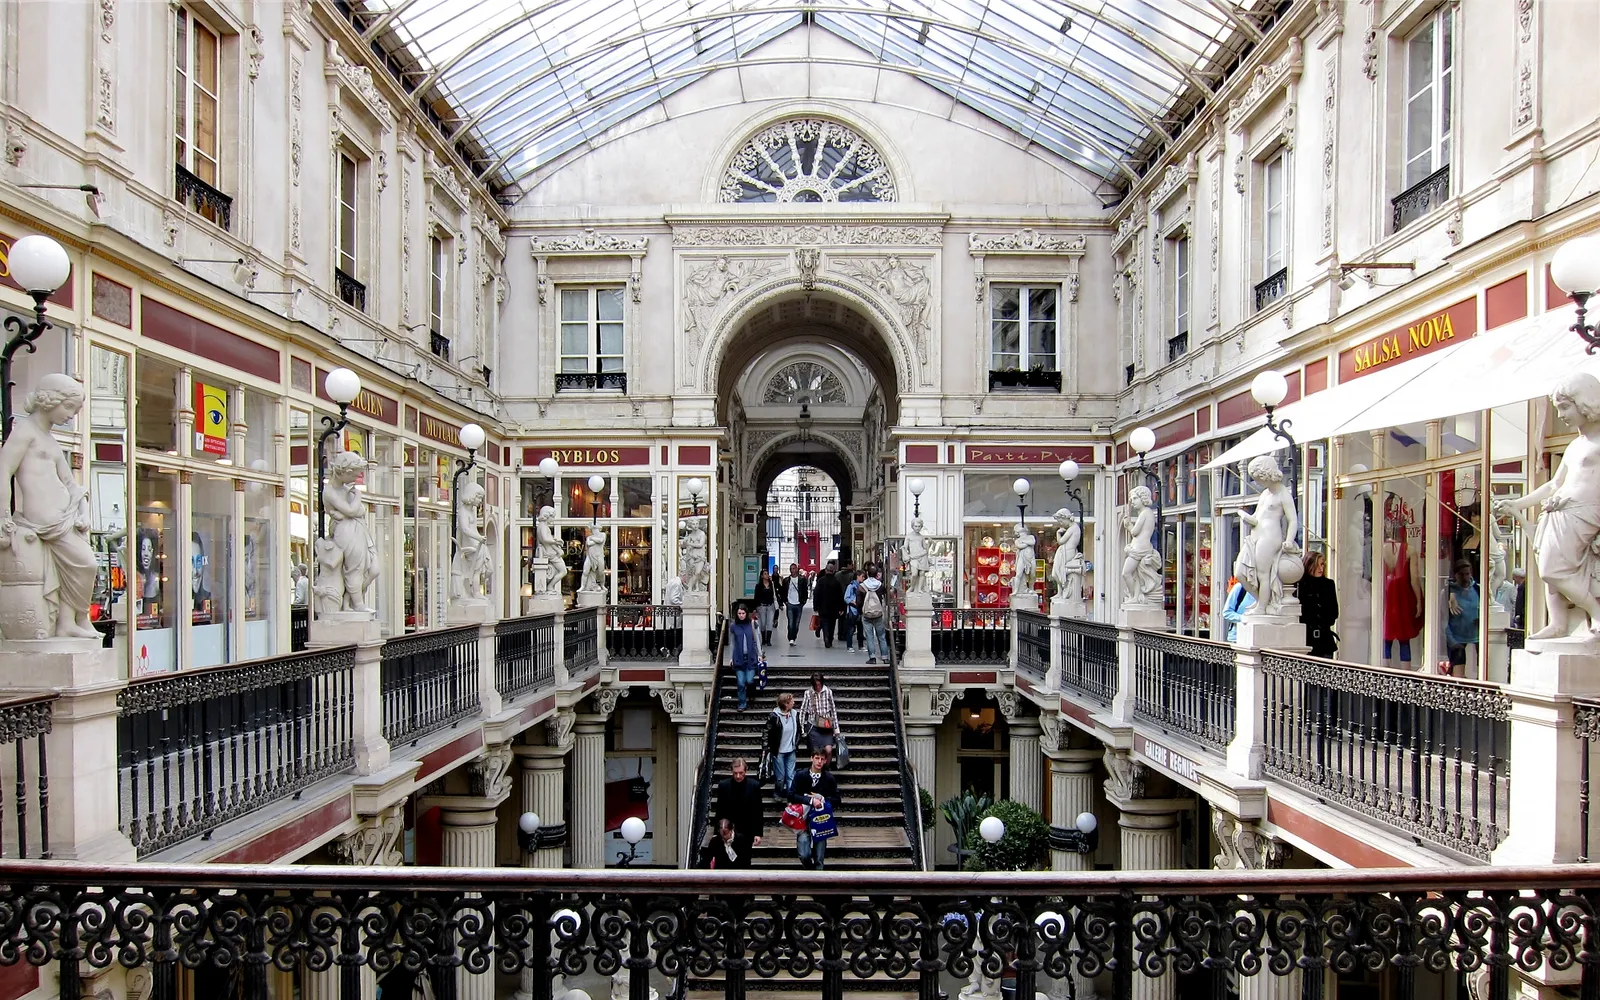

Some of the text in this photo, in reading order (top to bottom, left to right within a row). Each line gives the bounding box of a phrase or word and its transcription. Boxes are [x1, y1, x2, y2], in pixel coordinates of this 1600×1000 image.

[1354, 312, 1455, 373] SALSA NOVA
[551, 450, 620, 463] BYBLOS
[1144, 740, 1168, 767] GALERIE
